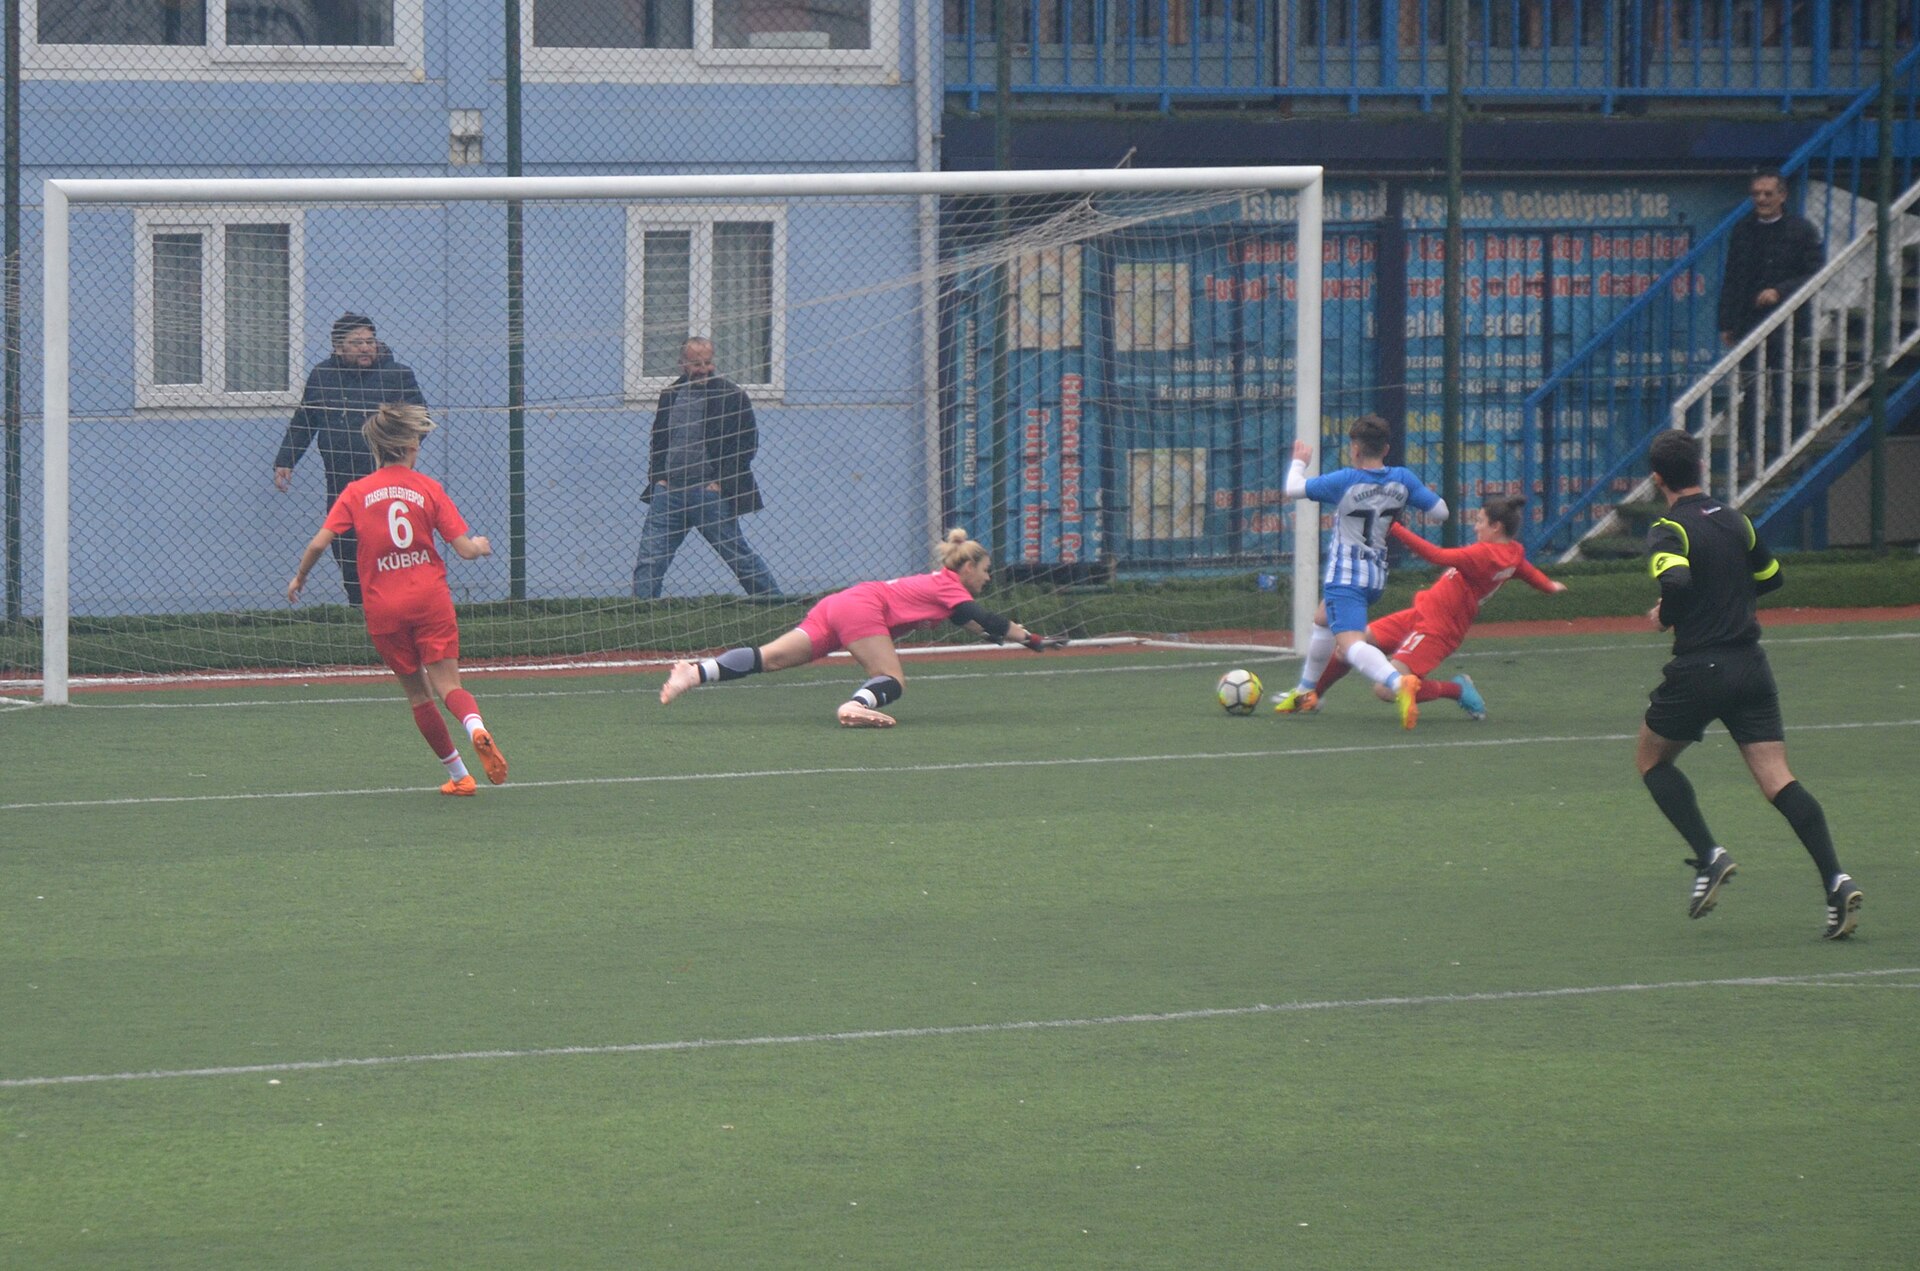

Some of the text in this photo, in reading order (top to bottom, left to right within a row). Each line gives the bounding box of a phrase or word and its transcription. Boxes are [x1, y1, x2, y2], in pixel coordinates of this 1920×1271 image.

[1060, 373, 1083, 523] Geleneksel
[388, 500, 414, 549] 6
[377, 549, 431, 573] KÜBRA
